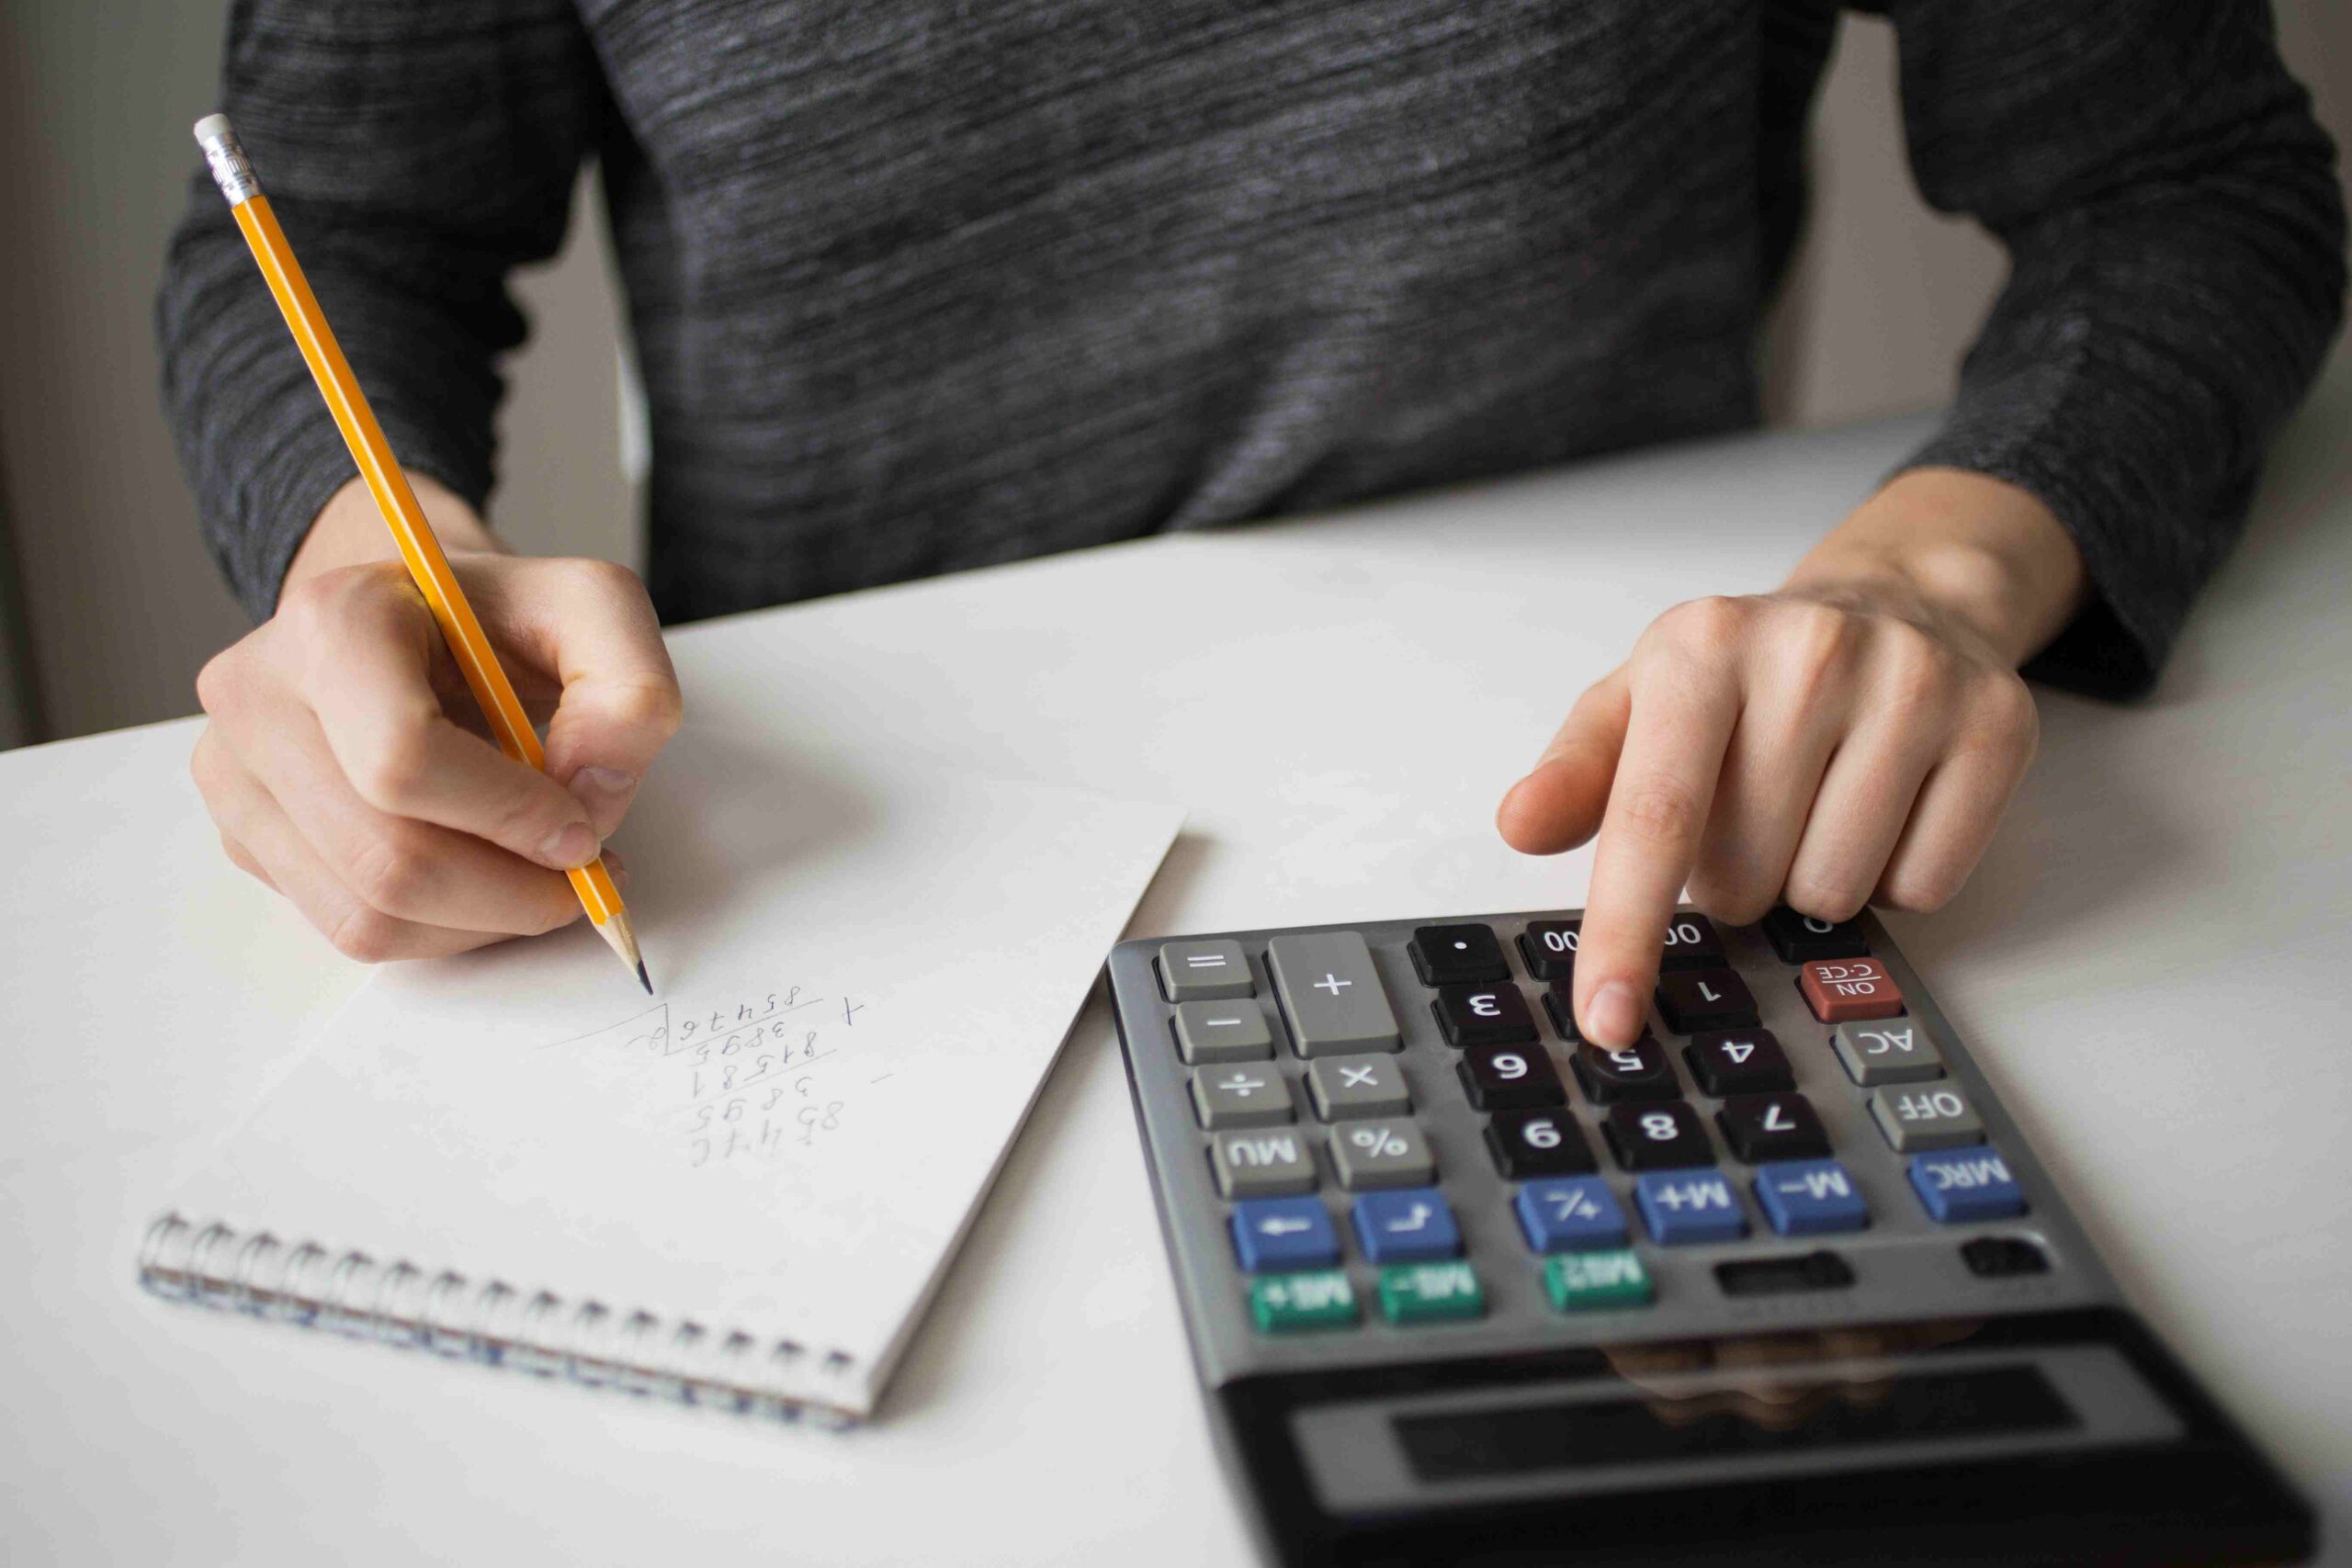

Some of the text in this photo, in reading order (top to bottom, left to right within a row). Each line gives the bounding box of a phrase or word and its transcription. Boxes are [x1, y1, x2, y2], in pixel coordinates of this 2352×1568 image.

[1697, 982, 1722, 1002] 1
[1837, 982, 1875, 997] ON
[1469, 995, 1501, 1017] 3
[1722, 1041, 1755, 1064] 4
[1858, 1028, 1914, 1055] AC
[1492, 1055, 1529, 1079] 6
[1610, 1050, 1645, 1071] 5
[1760, 1104, 1797, 1132] 7
[1897, 1093, 1964, 1121] OFF
[1523, 1121, 1562, 1147] 9
[1639, 1113, 1679, 1141] 8
[1228, 1139, 1296, 1167] MU
[1924, 1156, 2012, 1189] MRC
[1656, 1182, 1732, 1209] M+
